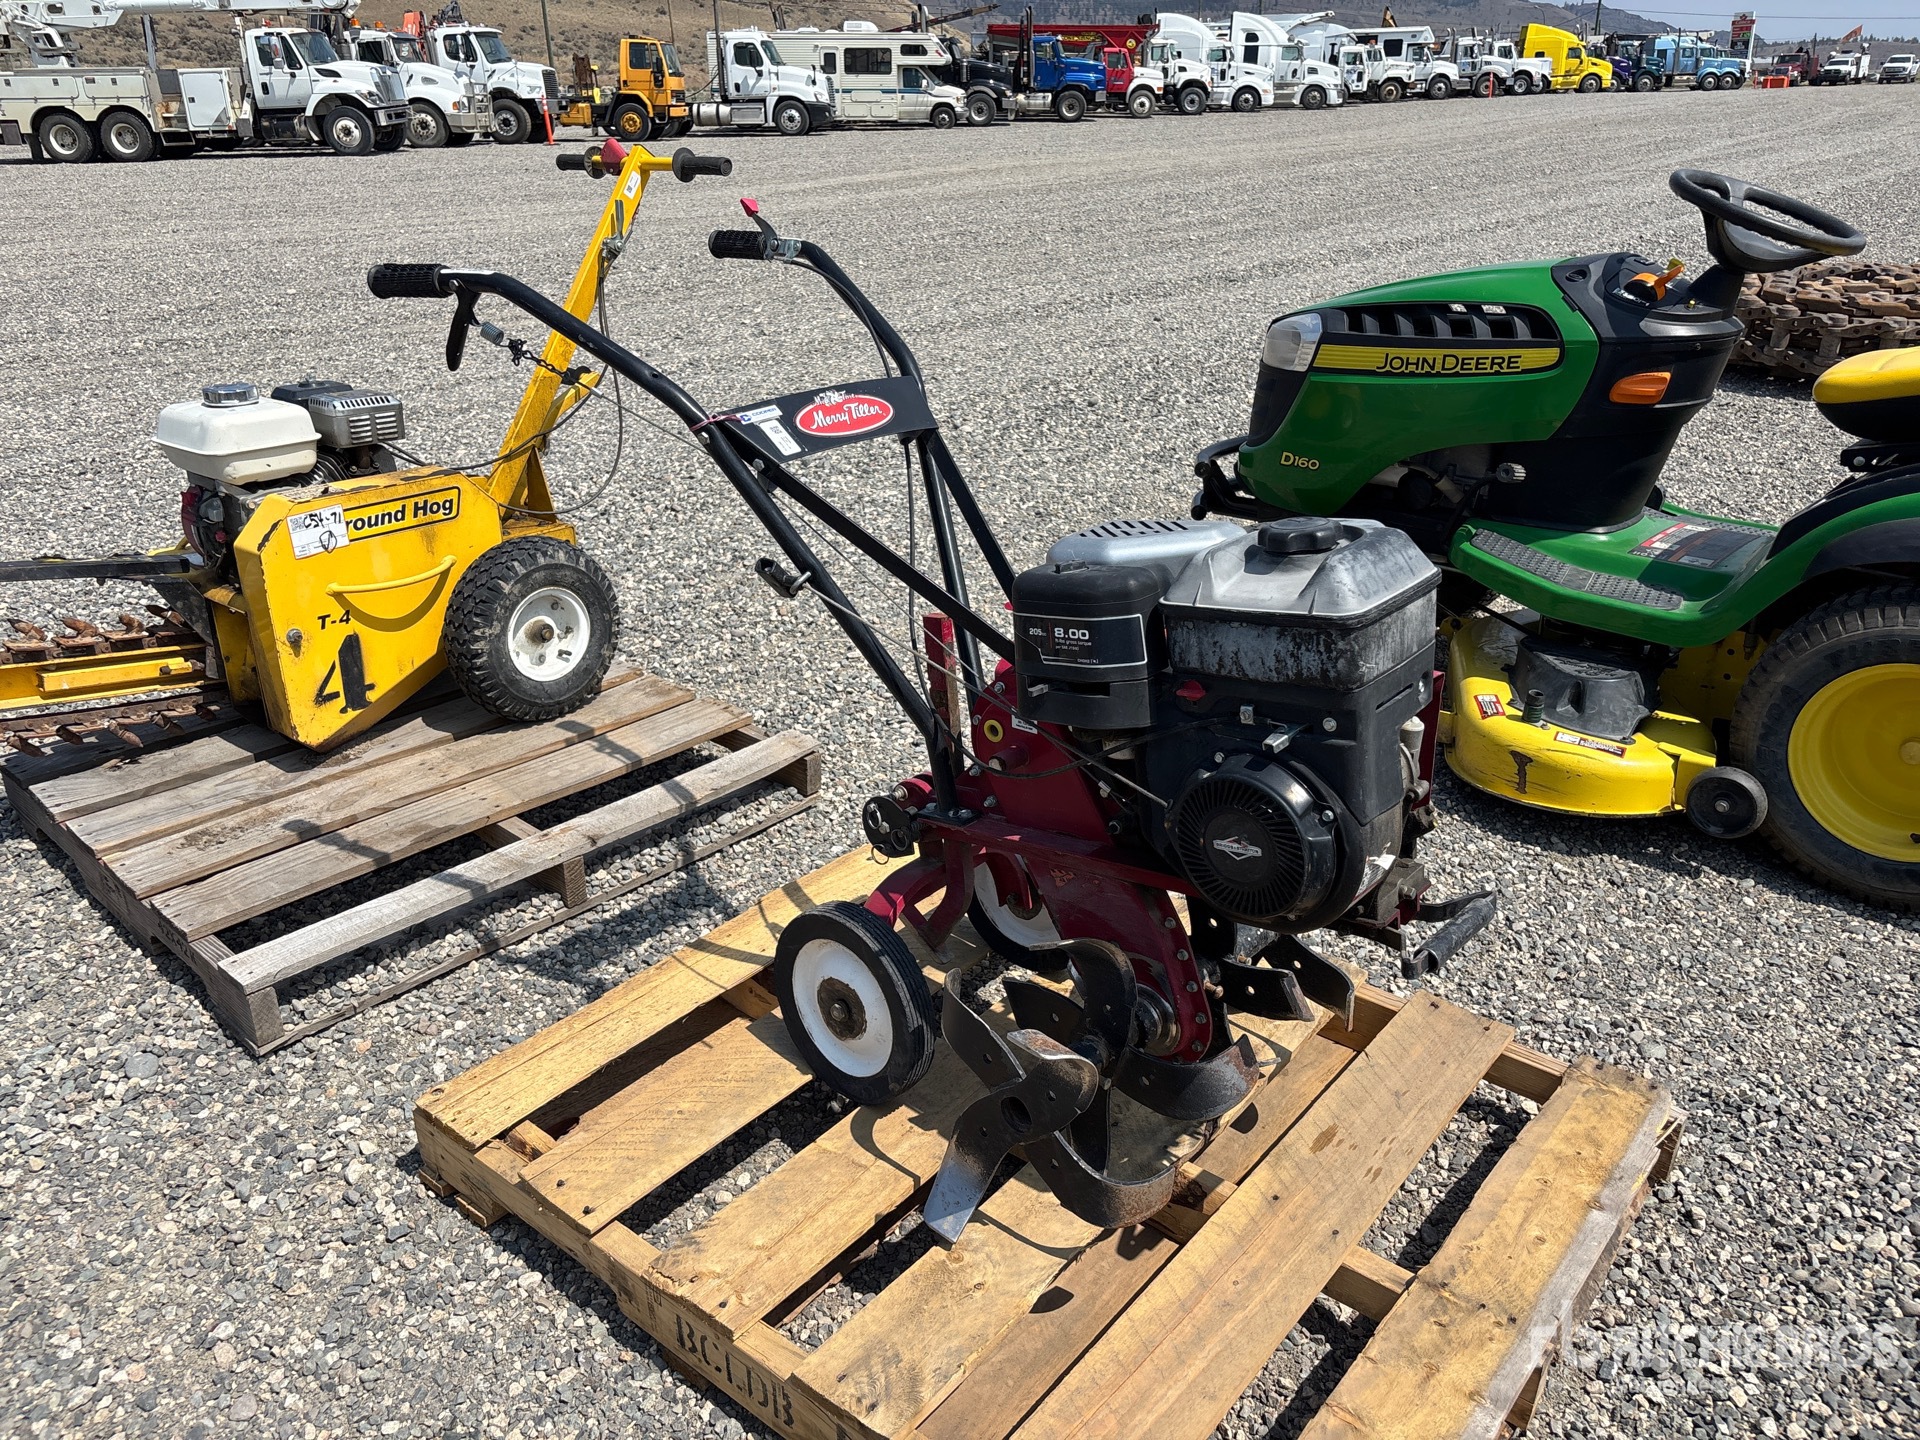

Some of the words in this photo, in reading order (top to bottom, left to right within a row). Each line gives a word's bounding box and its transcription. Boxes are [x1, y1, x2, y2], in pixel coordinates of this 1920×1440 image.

[1376, 352, 1437, 373] JOHN
[1441, 353, 1522, 373] DEERE
[810, 409, 851, 430] Merry
[843, 402, 882, 419] Tiller
[1280, 451, 1320, 470] D160
[345, 503, 406, 533] round
[413, 498, 454, 519] Hog
[317, 609, 351, 630] T-4
[1054, 627, 1089, 640] 8.00
[313, 632, 376, 714] 4
